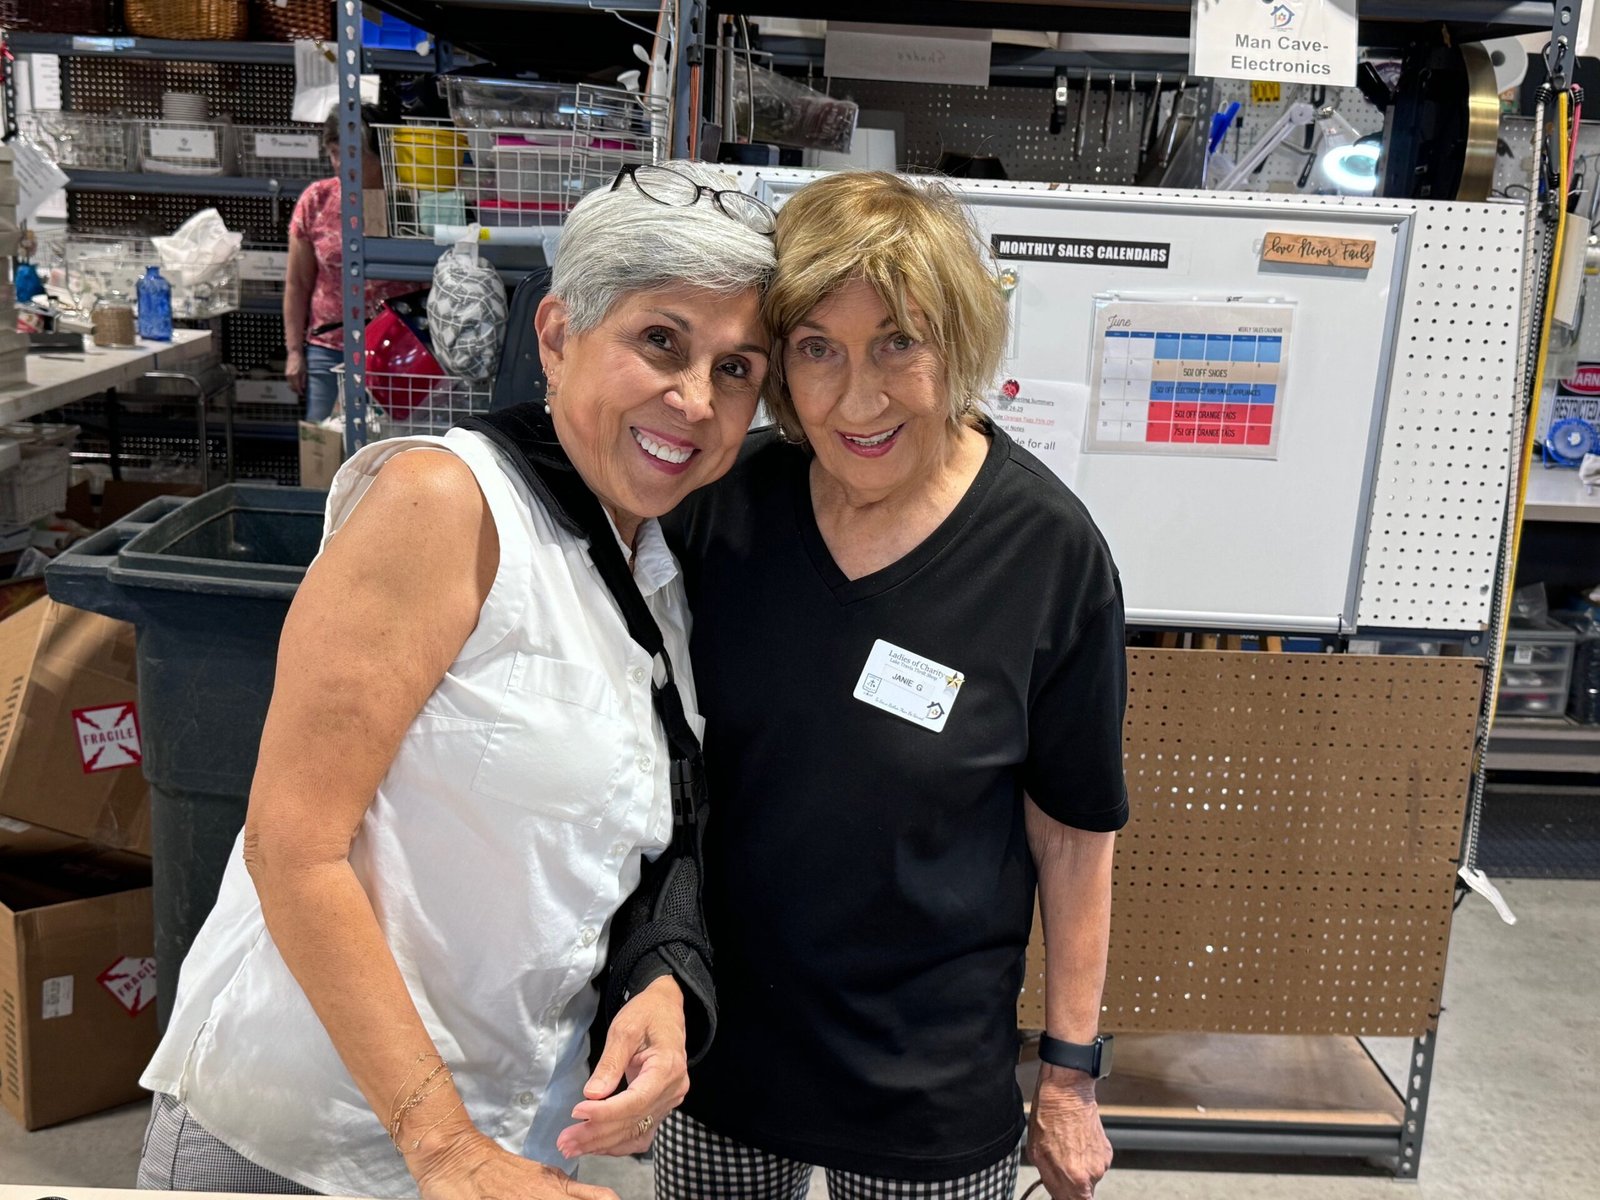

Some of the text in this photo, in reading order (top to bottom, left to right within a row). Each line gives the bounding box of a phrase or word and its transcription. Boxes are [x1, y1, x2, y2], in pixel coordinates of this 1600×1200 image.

[1235, 33, 1329, 52] Man Cave-
[1231, 55, 1331, 75] Electronics
[999, 240, 1168, 262] MONTHLY SALES CALENDARS
[1107, 314, 1132, 329] June
[1195, 369, 1207, 377] OFF
[1208, 369, 1228, 378] SHOES
[1186, 410, 1197, 418] OFF
[1198, 410, 1221, 419] ORANGE
[1222, 411, 1237, 420] TAGS
[1185, 428, 1196, 437] OFF
[1197, 429, 1220, 438] ORANGE
[1221, 429, 1236, 439] TAGS
[1027, 438, 1041, 449] for
[1043, 441, 1056, 451] all
[888, 649, 946, 679] Ladies of Charity
[891, 673, 914, 688] JANIE
[915, 684, 924, 692] G
[83, 727, 135, 746] FRAGILE
[117, 961, 156, 998] FRAGIL
